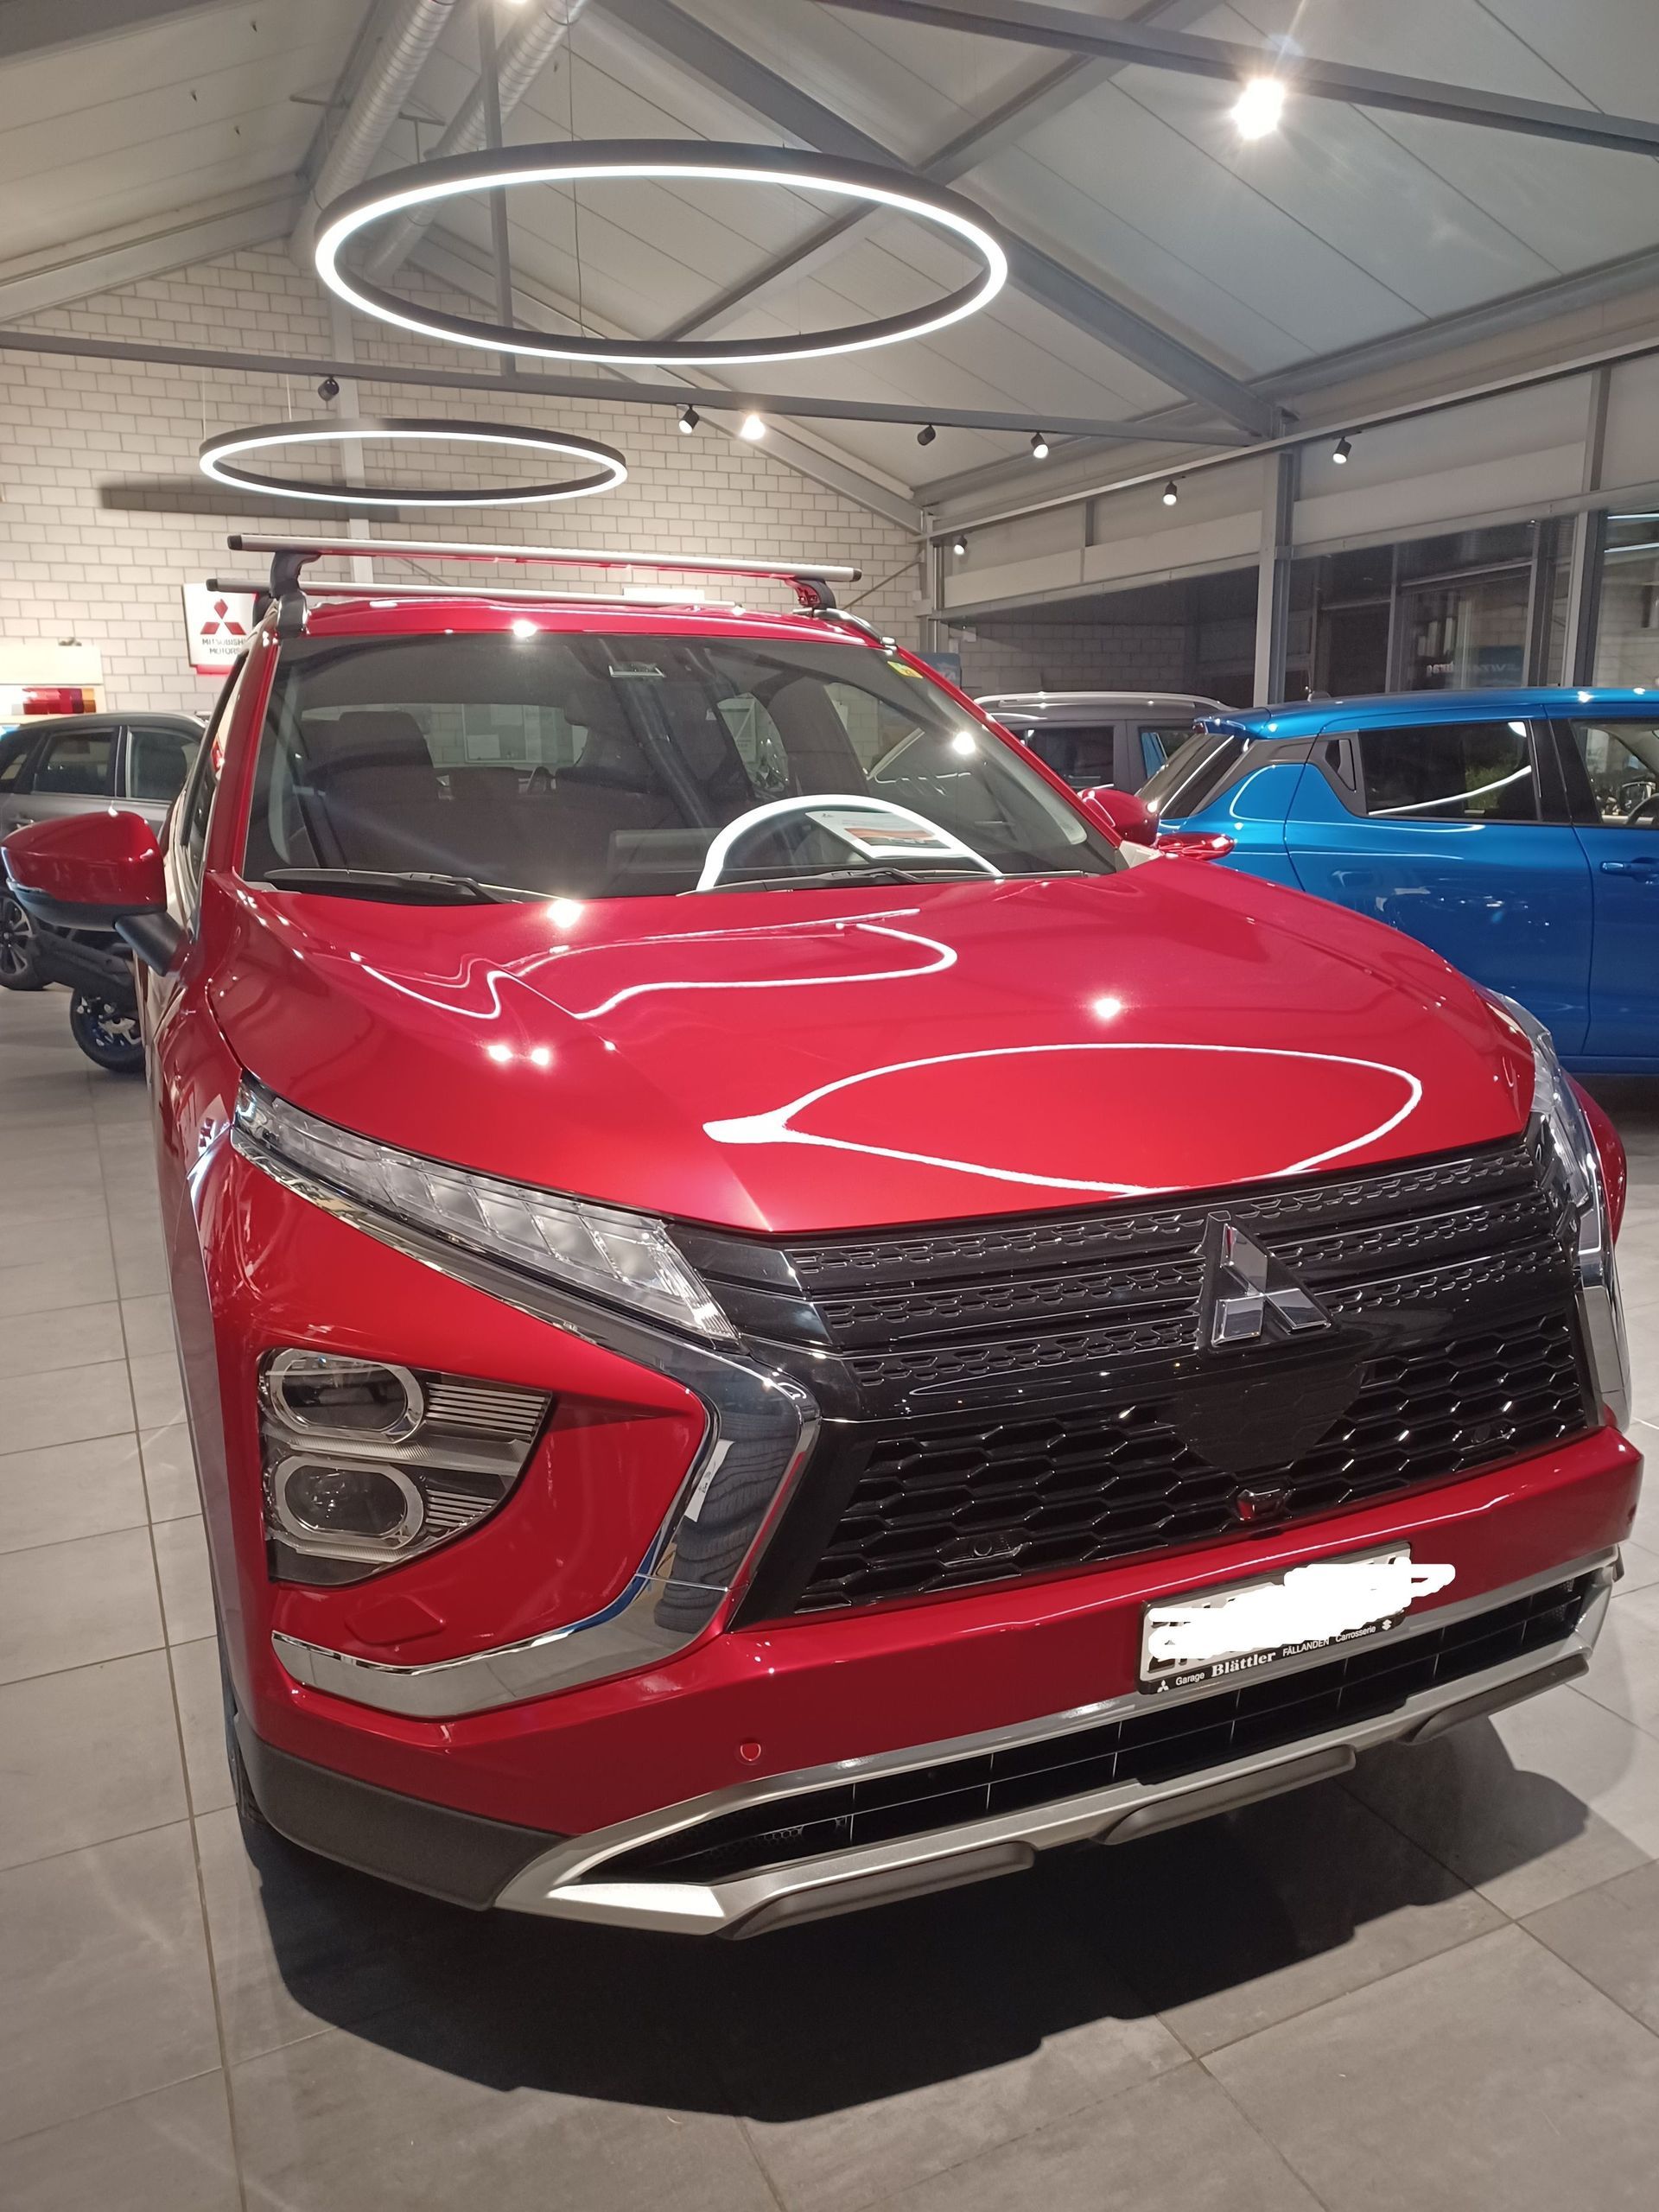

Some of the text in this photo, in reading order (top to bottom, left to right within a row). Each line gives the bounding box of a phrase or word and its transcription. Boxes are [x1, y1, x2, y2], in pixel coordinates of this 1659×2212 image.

[1175, 1672, 1205, 1686] Garage
[1211, 1651, 1276, 1677] Blättler
[1335, 1625, 1376, 1643] Carrosserie
